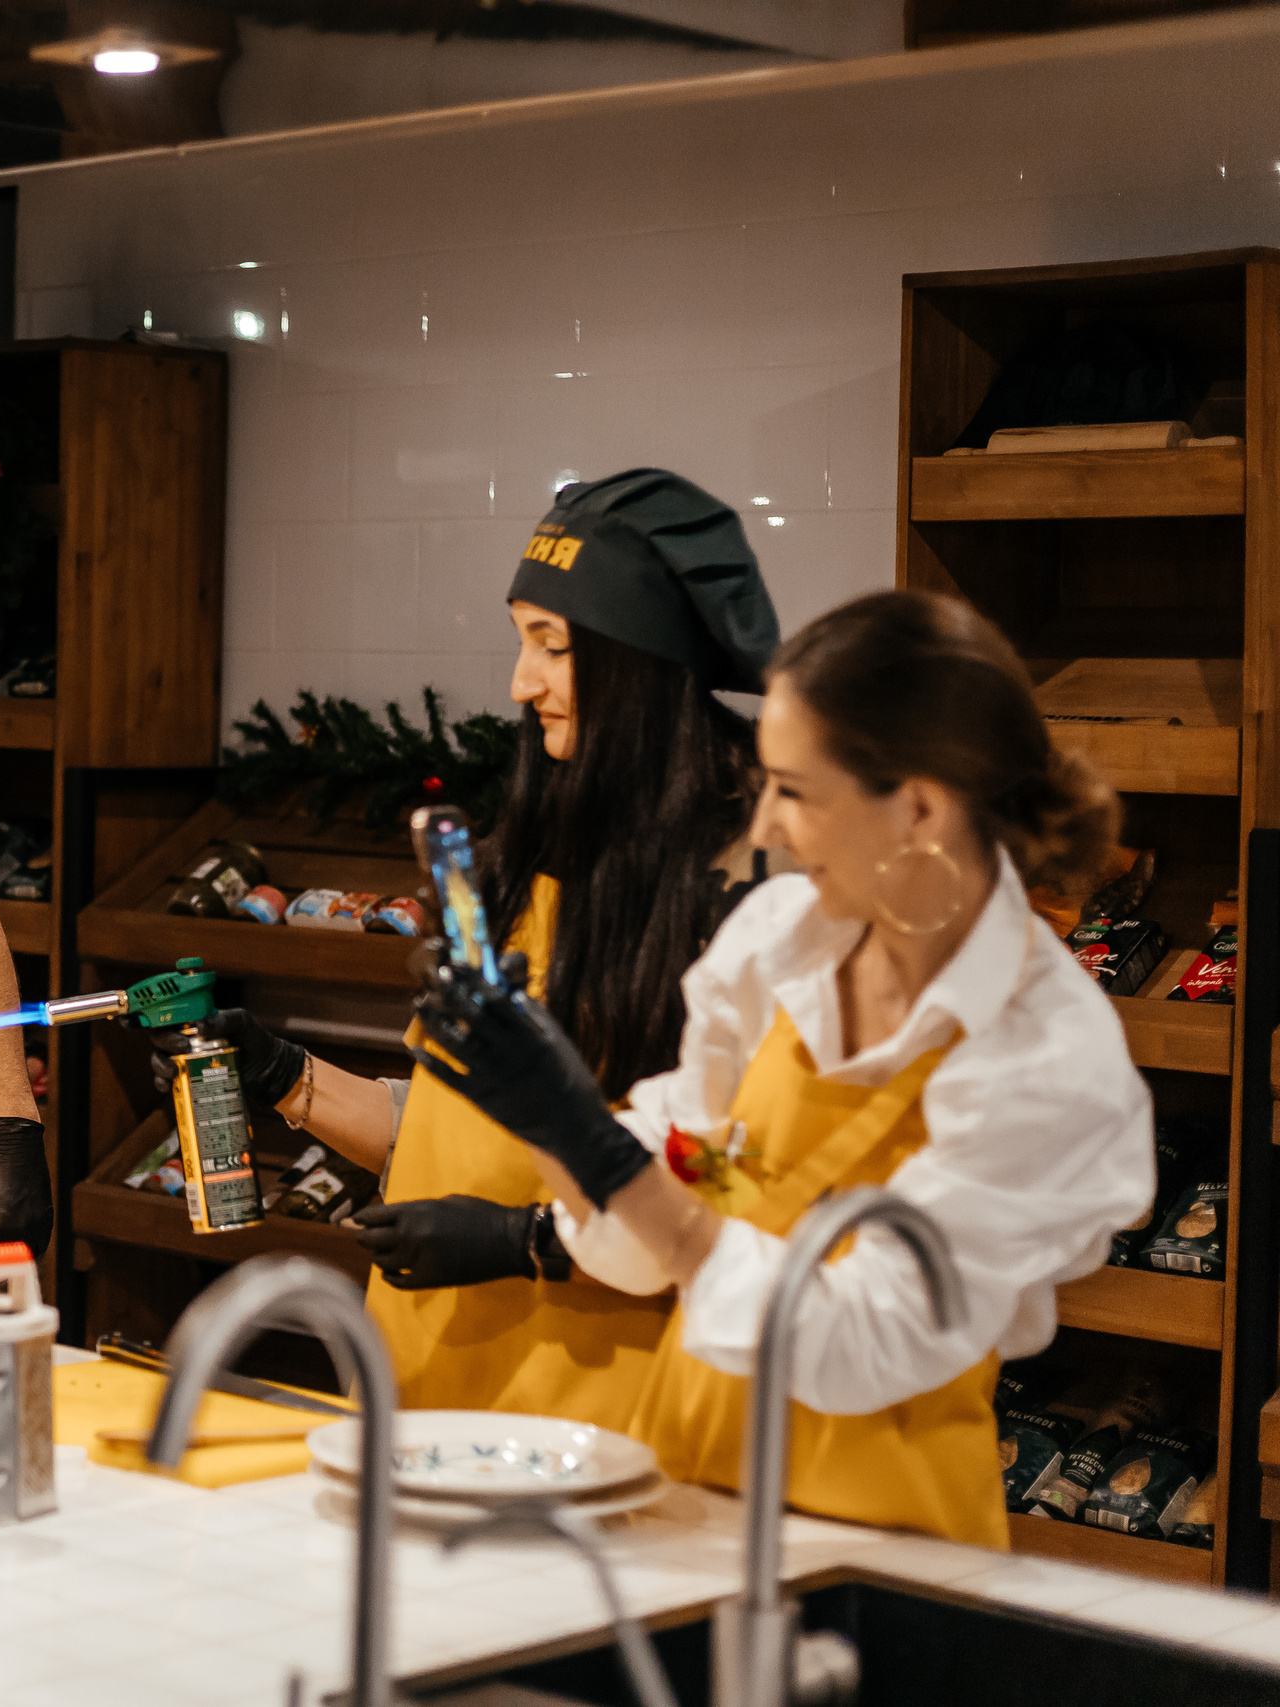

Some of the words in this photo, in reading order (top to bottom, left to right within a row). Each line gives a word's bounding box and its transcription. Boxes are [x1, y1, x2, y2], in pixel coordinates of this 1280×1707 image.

[1074, 930, 1103, 940] Gallo
[1198, 961, 1238, 975] Ven
[1197, 1182, 1229, 1191] DELVE
[1006, 1410, 1056, 1429] DELVERDE
